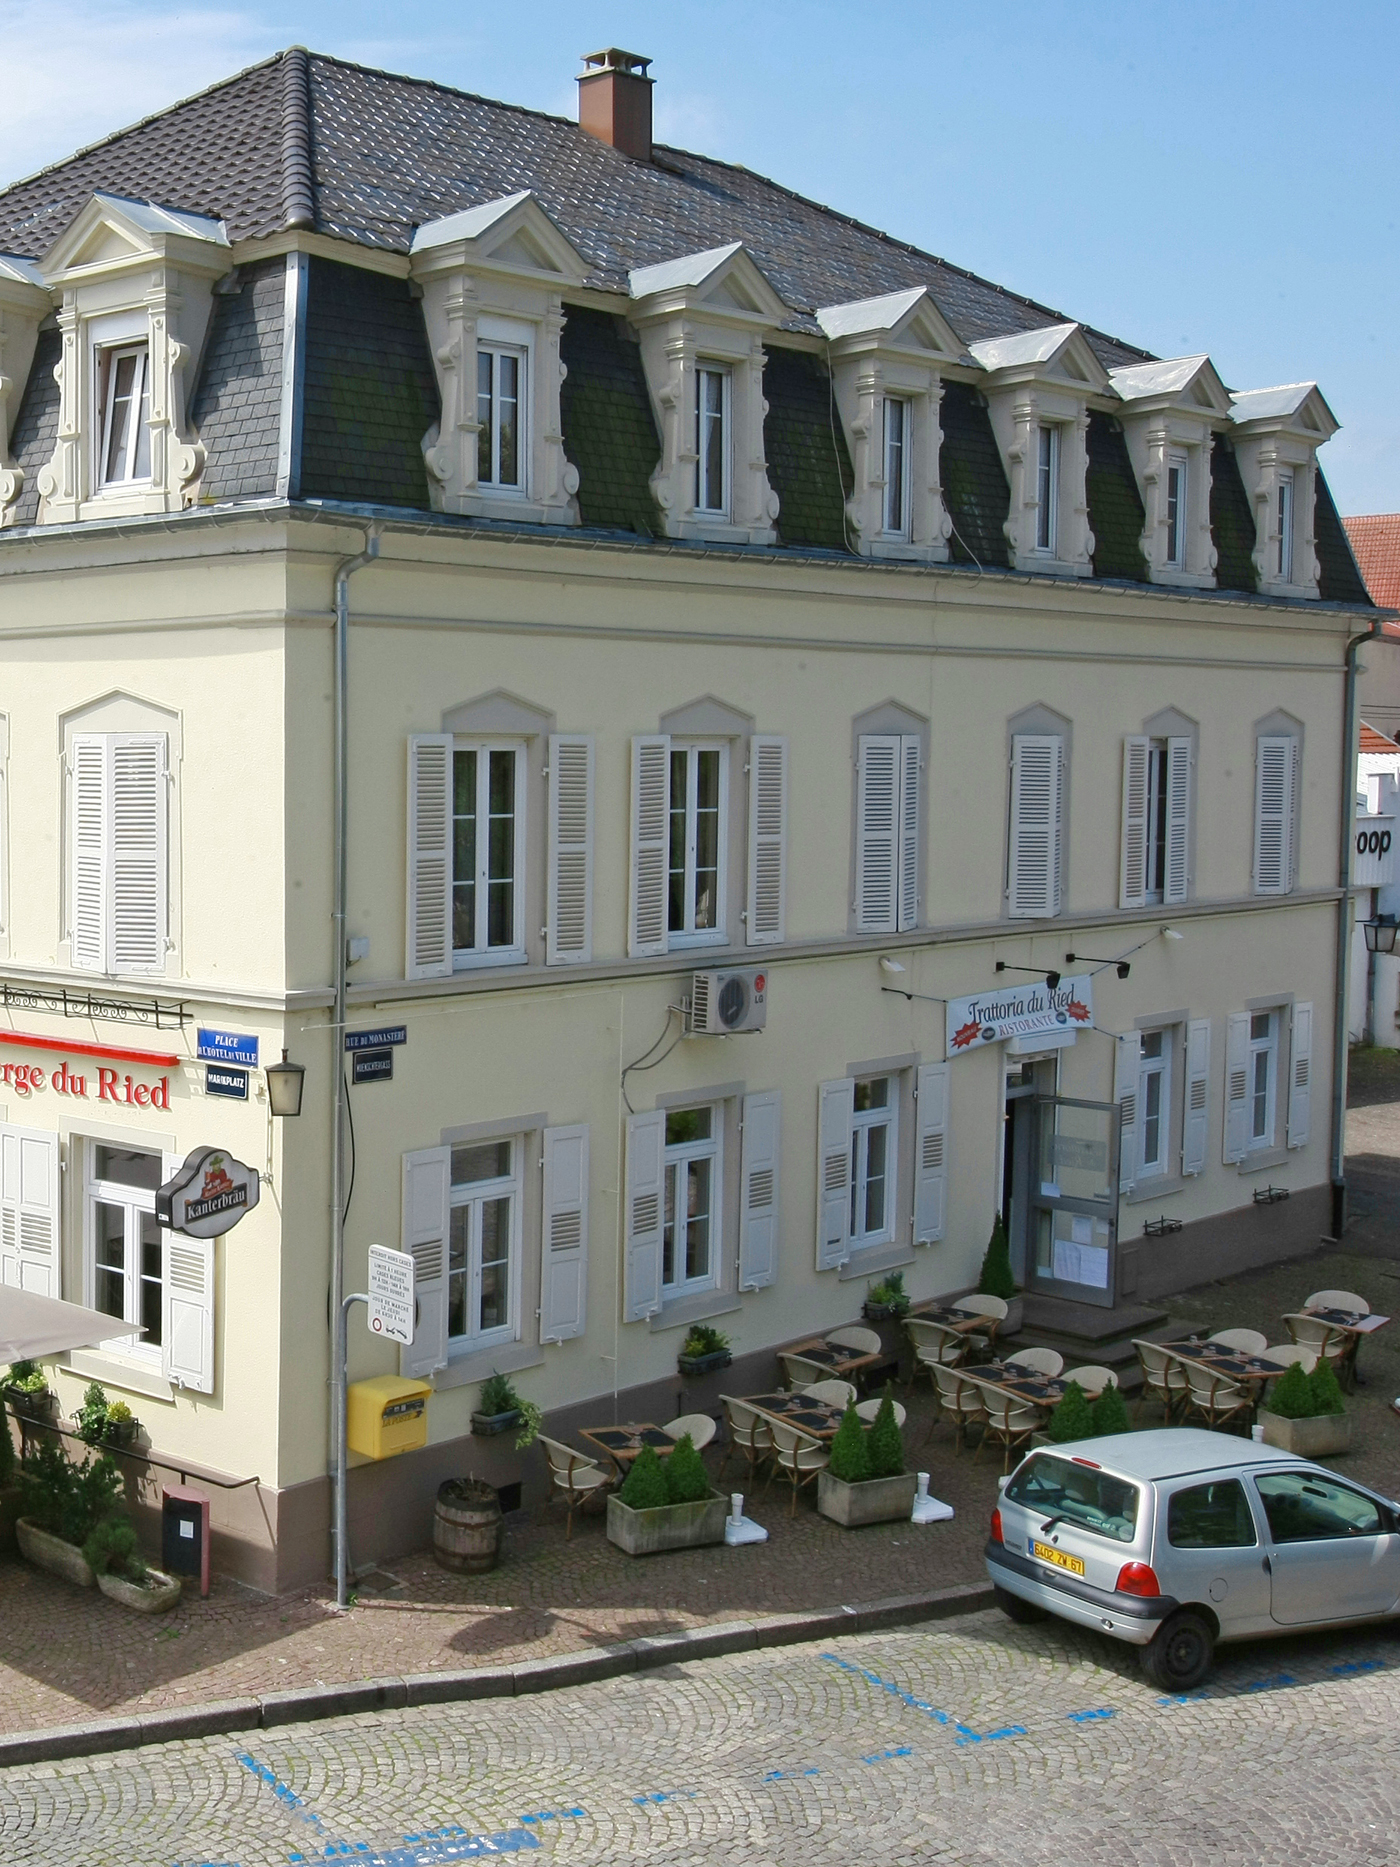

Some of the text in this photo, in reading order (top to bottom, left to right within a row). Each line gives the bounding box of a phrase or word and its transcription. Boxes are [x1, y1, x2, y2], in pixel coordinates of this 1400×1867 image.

[1355, 830, 1391, 861] oop
[755, 994, 764, 1004] LG
[968, 983, 1075, 1024] Trattoria du Ried
[998, 1014, 1054, 1037] RISTORANTE
[215, 1035, 238, 1048] PLACE
[346, 1036, 359, 1047] RUE
[360, 1036, 368, 1045] DU
[235, 1051, 257, 1063] VILLE
[52, 1061, 87, 1097] du
[95, 1066, 171, 1110] Ried
[187, 1190, 245, 1220] Kanterbräu
[1034, 1543, 1054, 1562] 6402
[1070, 1558, 1082, 1573] 67
